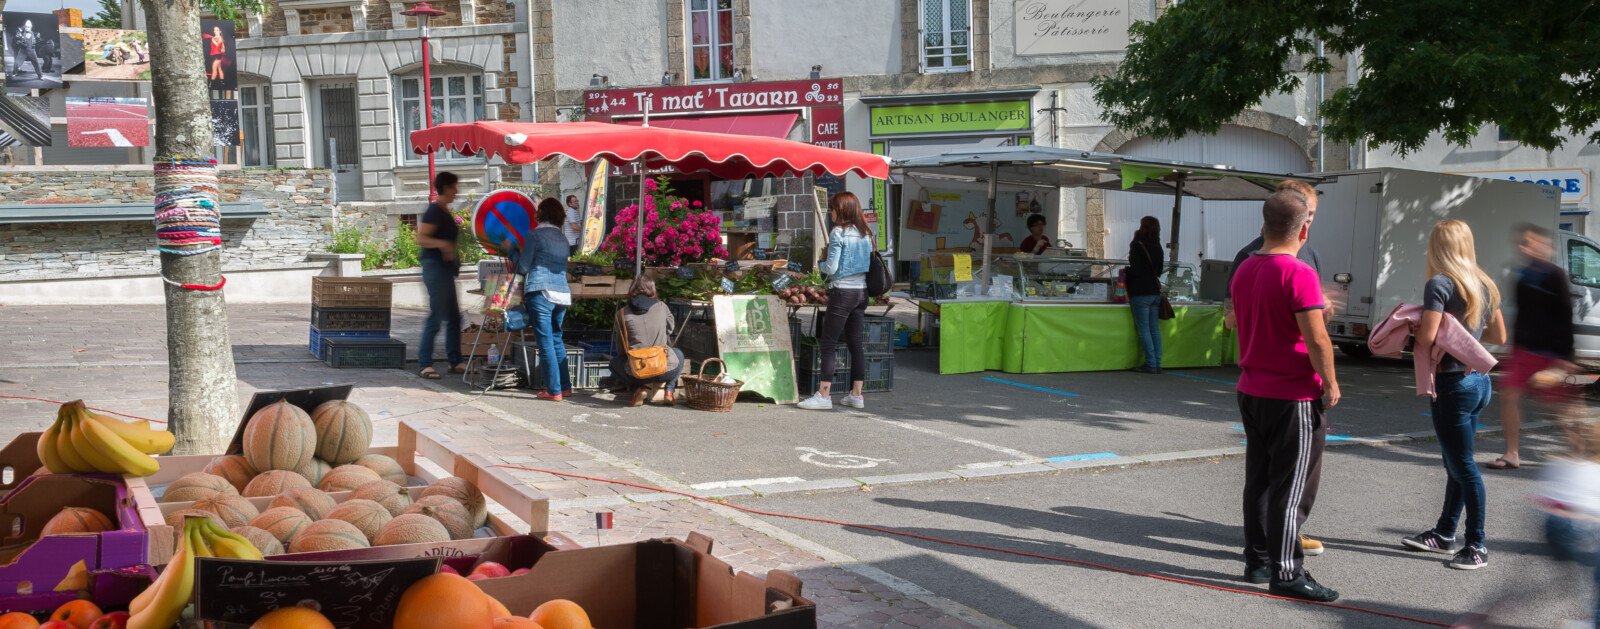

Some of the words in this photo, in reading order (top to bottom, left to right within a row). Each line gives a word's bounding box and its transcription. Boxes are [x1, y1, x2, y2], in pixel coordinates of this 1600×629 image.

[1023, 2, 1120, 22] Boulangerie
[1034, 20, 1110, 37] Pâtisserie
[588, 92, 600, 100] 29
[610, 97, 627, 107] 44
[826, 94, 839, 102] 22
[876, 113, 934, 126] ARTISAN
[941, 109, 1026, 123] BOULANGER
[817, 122, 838, 135] CAFE
